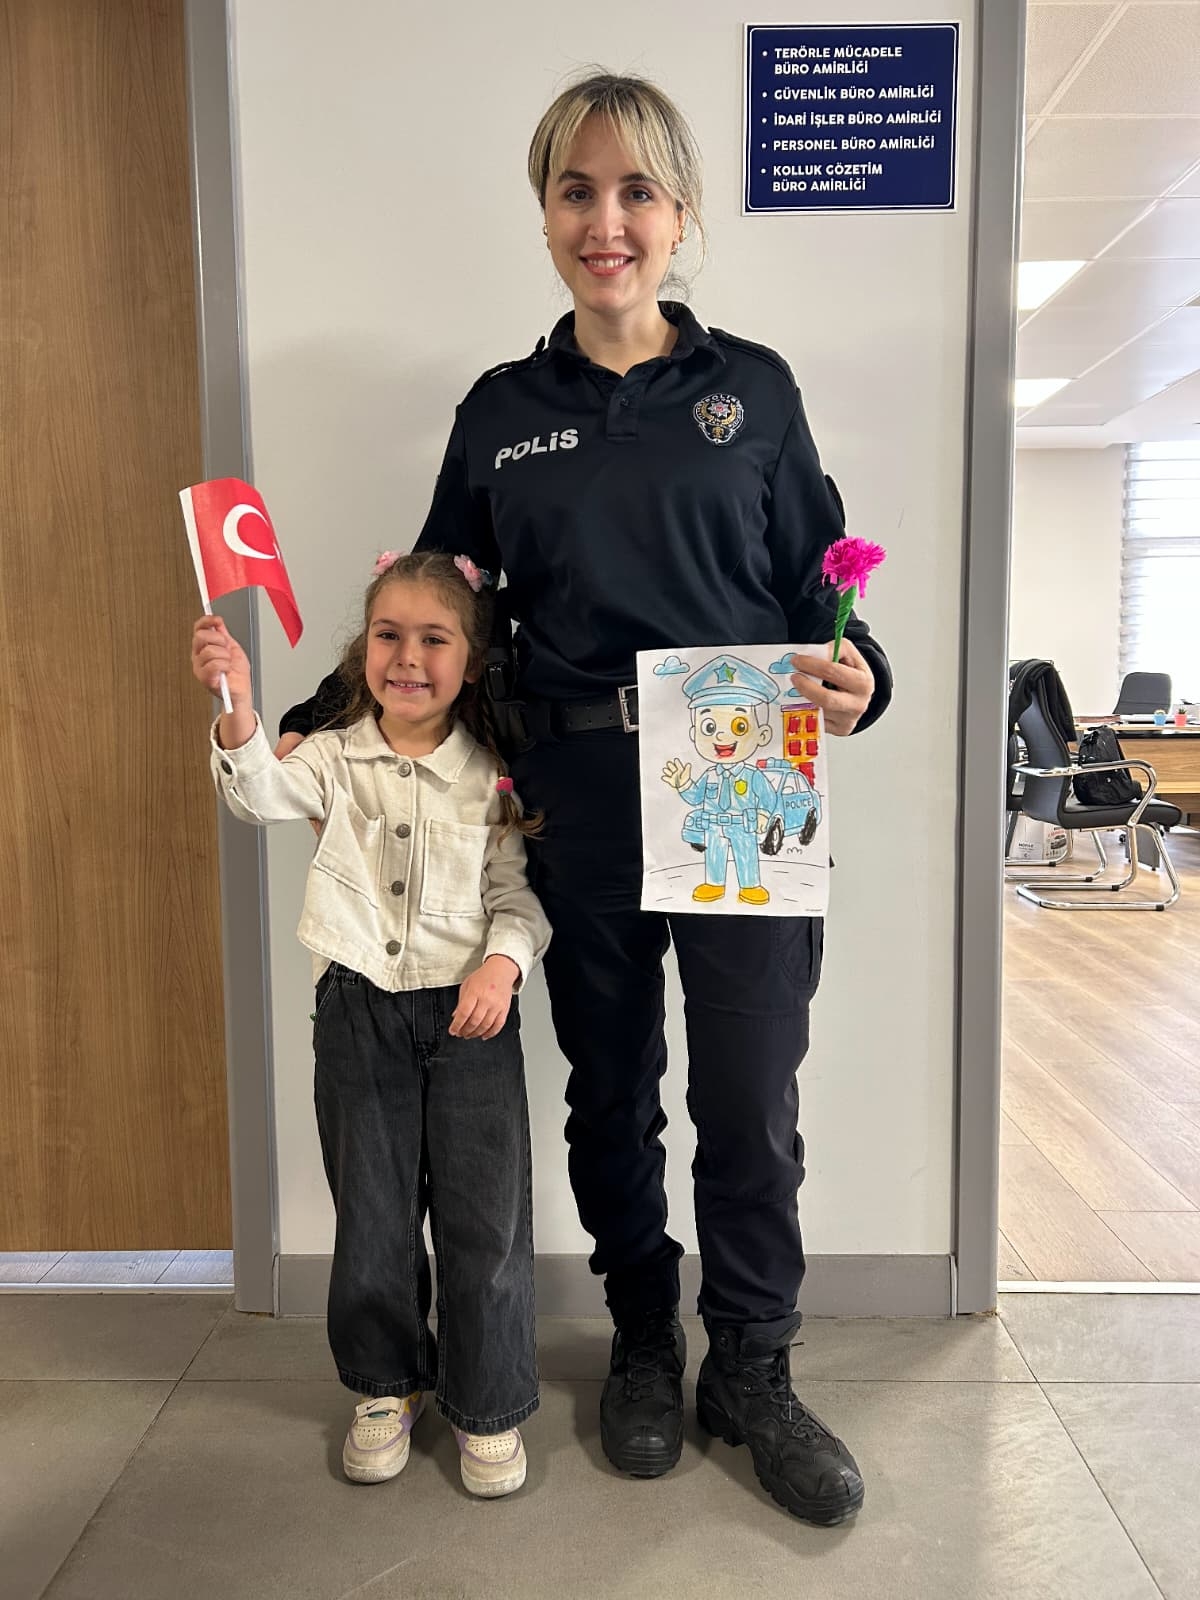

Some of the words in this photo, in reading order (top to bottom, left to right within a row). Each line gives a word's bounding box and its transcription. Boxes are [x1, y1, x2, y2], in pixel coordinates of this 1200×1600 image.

[775, 45, 830, 58] TERÖRLE
[834, 45, 902, 58] MÜCADELE
[774, 61, 809, 75] BÜRO
[812, 60, 869, 74] AMİRLİĞİ
[774, 86, 837, 100] GÜVENLİK
[840, 86, 875, 99] BÜRO
[878, 85, 934, 99] AMİRLİĞİ
[774, 112, 806, 126] İDARİ
[810, 111, 845, 128] İŞLER
[848, 111, 883, 125] BÜRO
[886, 110, 942, 124] AMİRLİĞİ
[773, 139, 838, 151] PERSONEL
[841, 136, 876, 150] BÜRO
[879, 135, 935, 149] AMİRLİĞİ
[773, 164, 823, 176] KOLLUK
[825, 162, 883, 176] GÖZETİM
[773, 178, 807, 192] BÜRO
[810, 178, 866, 192] AMİRLİĞİ
[785, 798, 812, 809] POLICE
